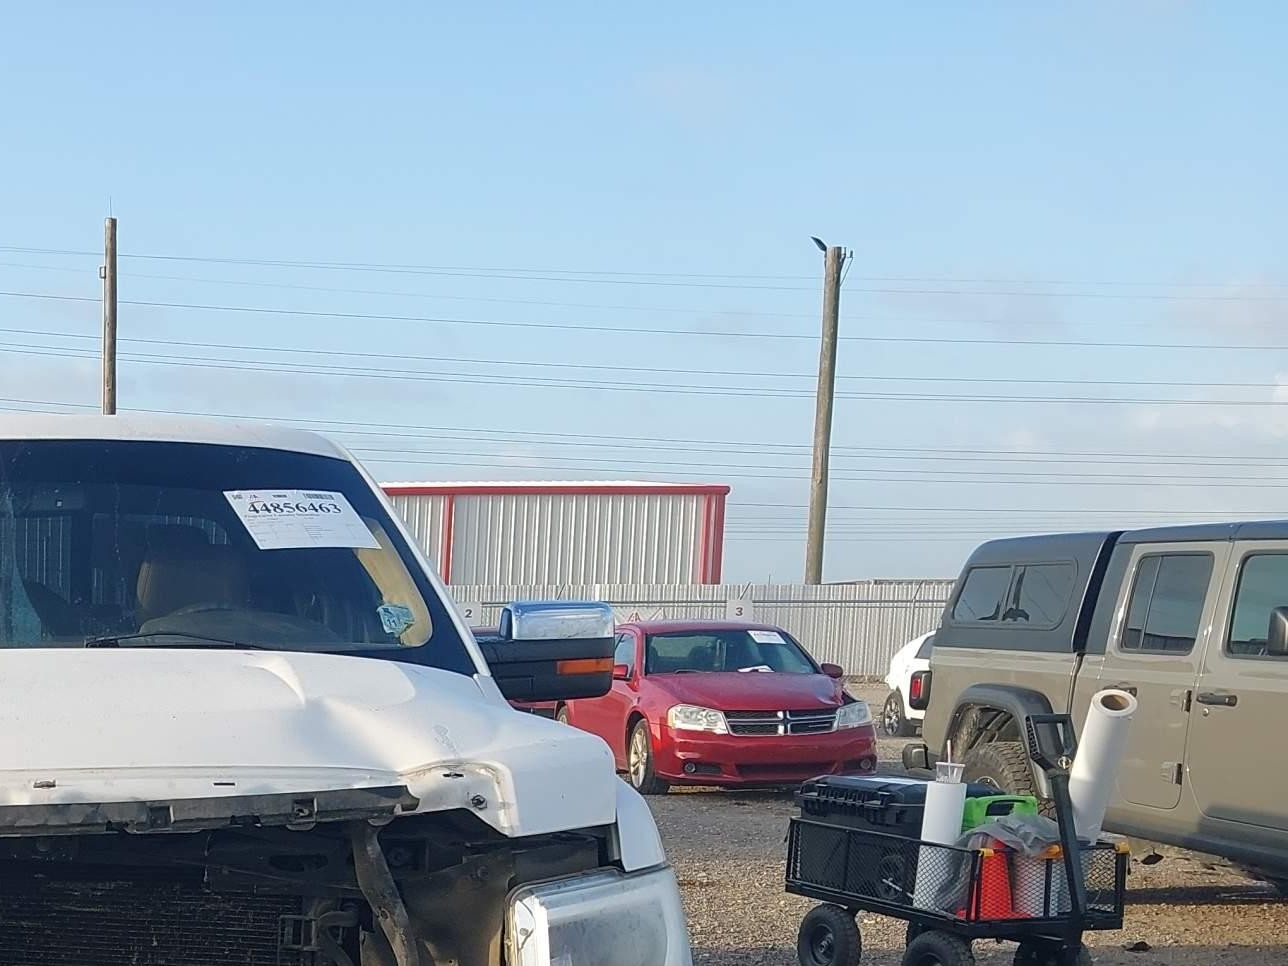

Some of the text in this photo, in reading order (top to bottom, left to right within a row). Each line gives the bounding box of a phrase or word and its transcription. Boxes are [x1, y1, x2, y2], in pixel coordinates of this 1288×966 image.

[248, 502, 342, 514] 44856463
[464, 608, 473, 619] 2
[735, 606, 743, 617] 3
